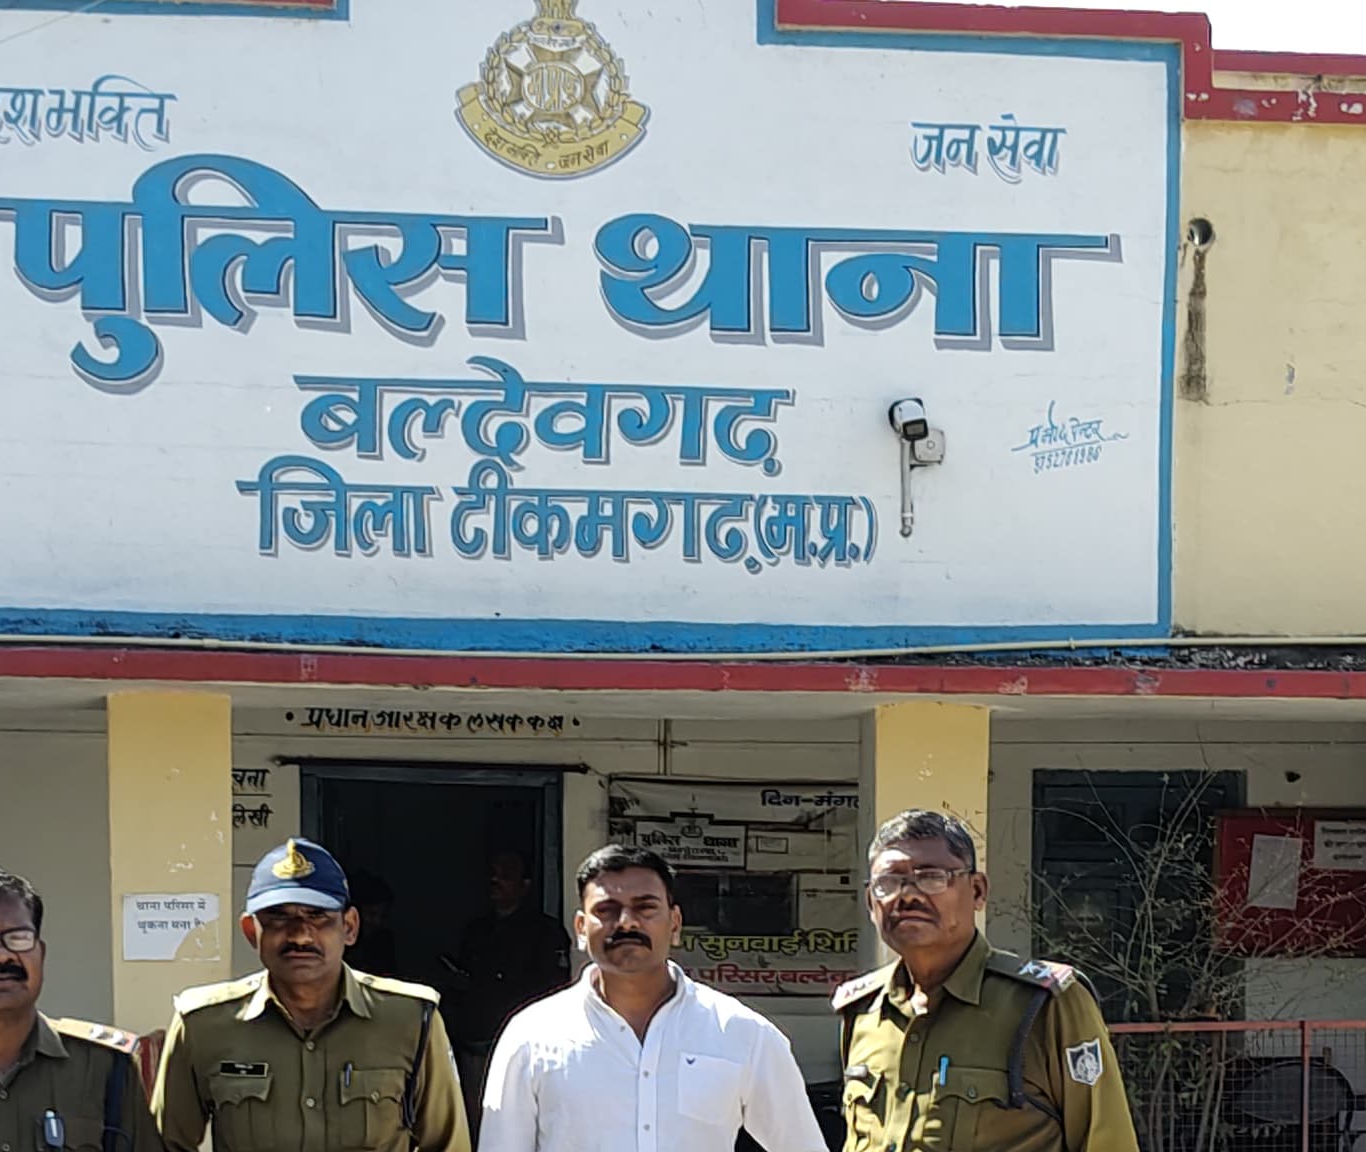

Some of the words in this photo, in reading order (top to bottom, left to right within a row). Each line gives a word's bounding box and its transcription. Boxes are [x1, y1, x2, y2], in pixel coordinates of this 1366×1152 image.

[593, 213, 1122, 351] थाना
[235, 454, 442, 562] जिला
[699, 928, 804, 962] सुनवाई
